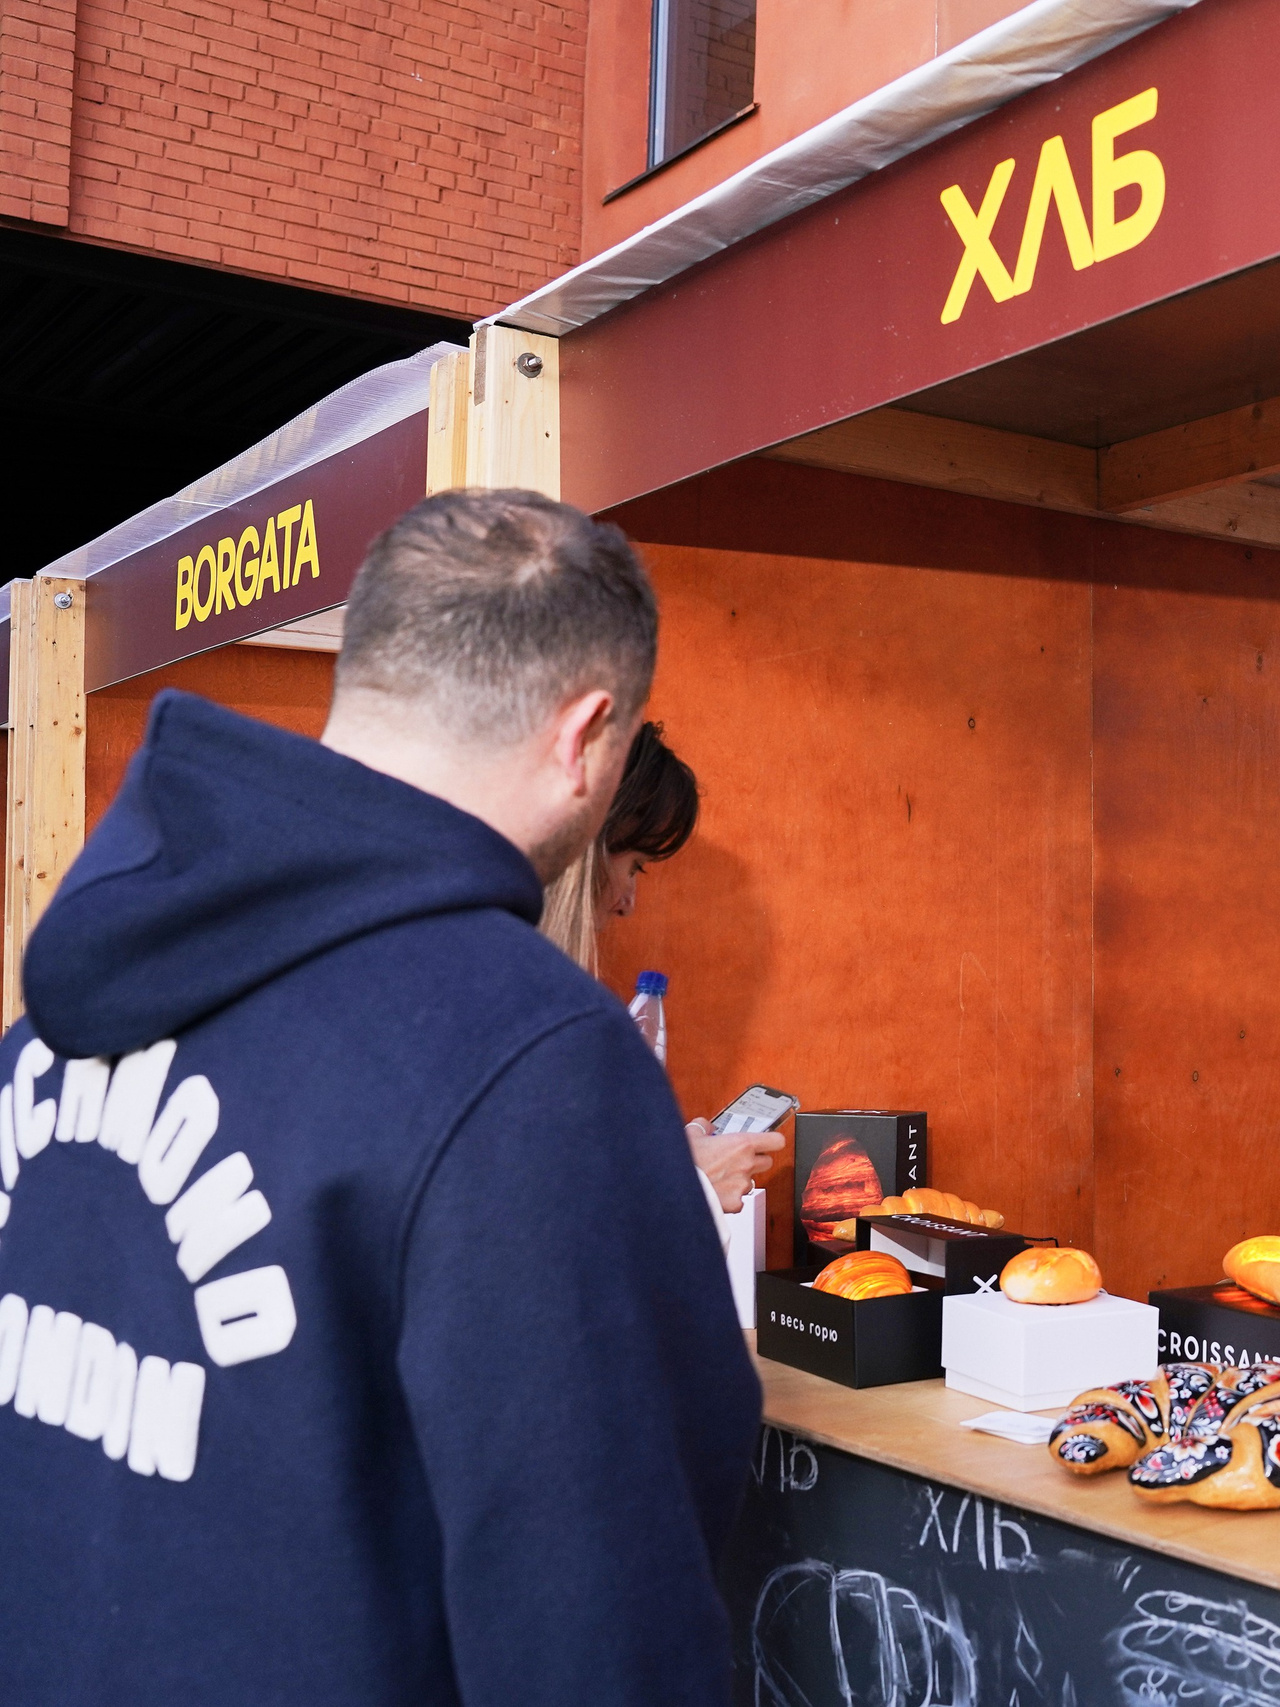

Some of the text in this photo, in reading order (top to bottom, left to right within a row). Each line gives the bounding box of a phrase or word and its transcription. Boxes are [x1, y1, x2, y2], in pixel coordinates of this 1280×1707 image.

[940, 87, 1165, 324] ХЛБ
[175, 499, 320, 631] BORGATA
[0, 1038, 297, 1368] ICHMOND
[770, 1310, 838, 1343] я весь горю
